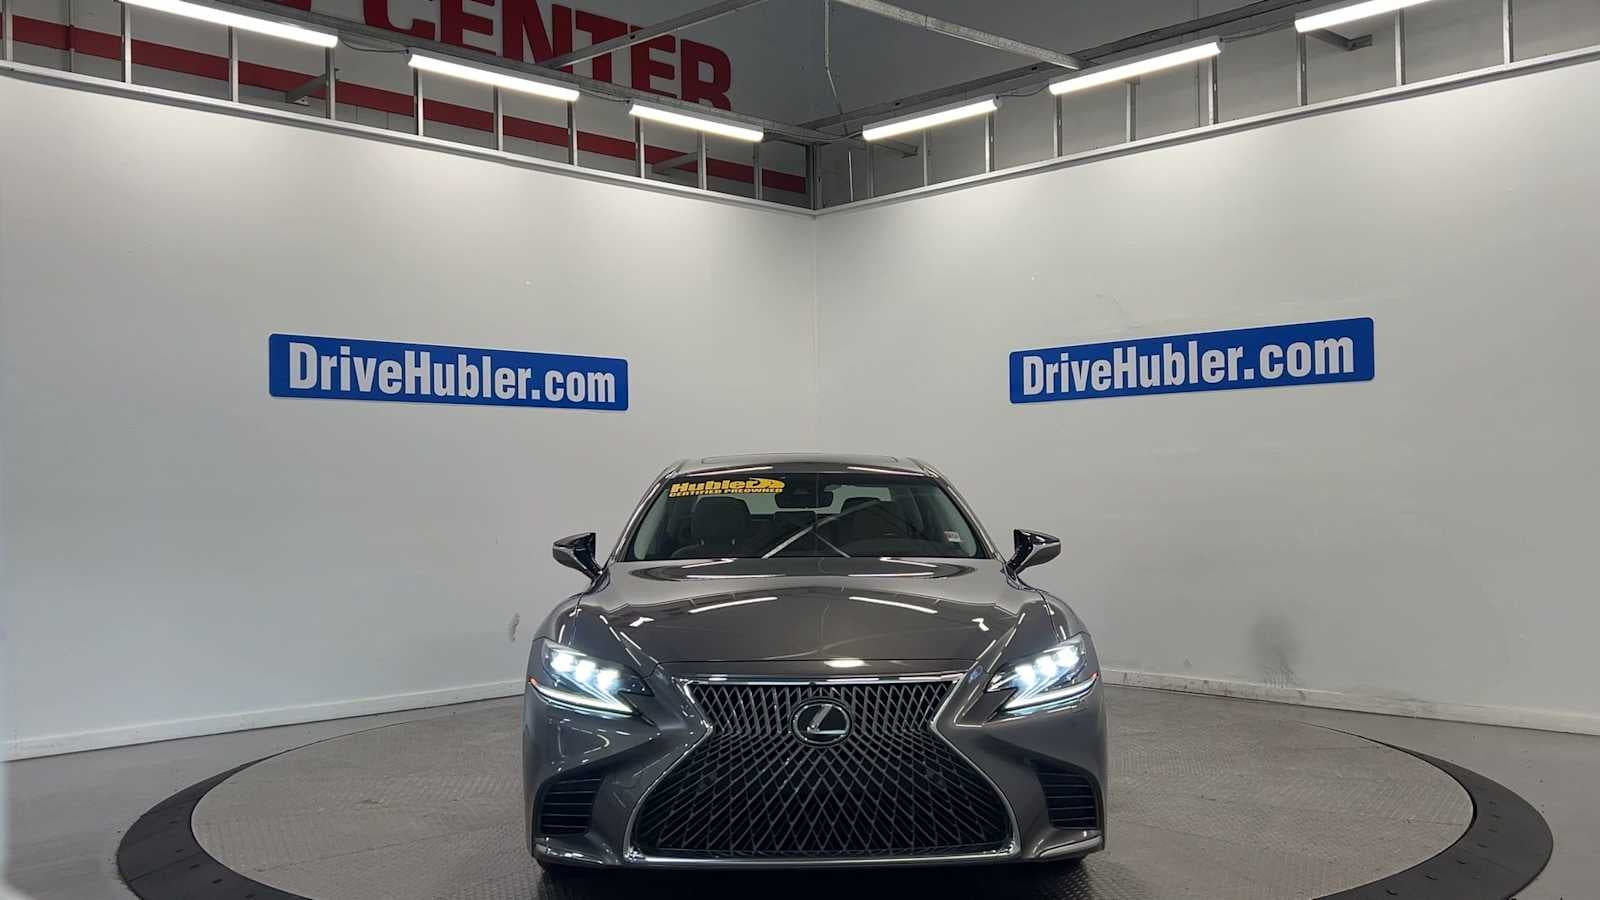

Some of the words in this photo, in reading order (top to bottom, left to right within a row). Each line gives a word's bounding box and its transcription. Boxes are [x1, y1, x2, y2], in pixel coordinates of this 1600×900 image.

[288, 342, 616, 403] DriveHubler.com
[1022, 336, 1355, 396] DriveHubler.com
[668, 488, 721, 497] CERTIFIED
[670, 480, 759, 493] Hubler
